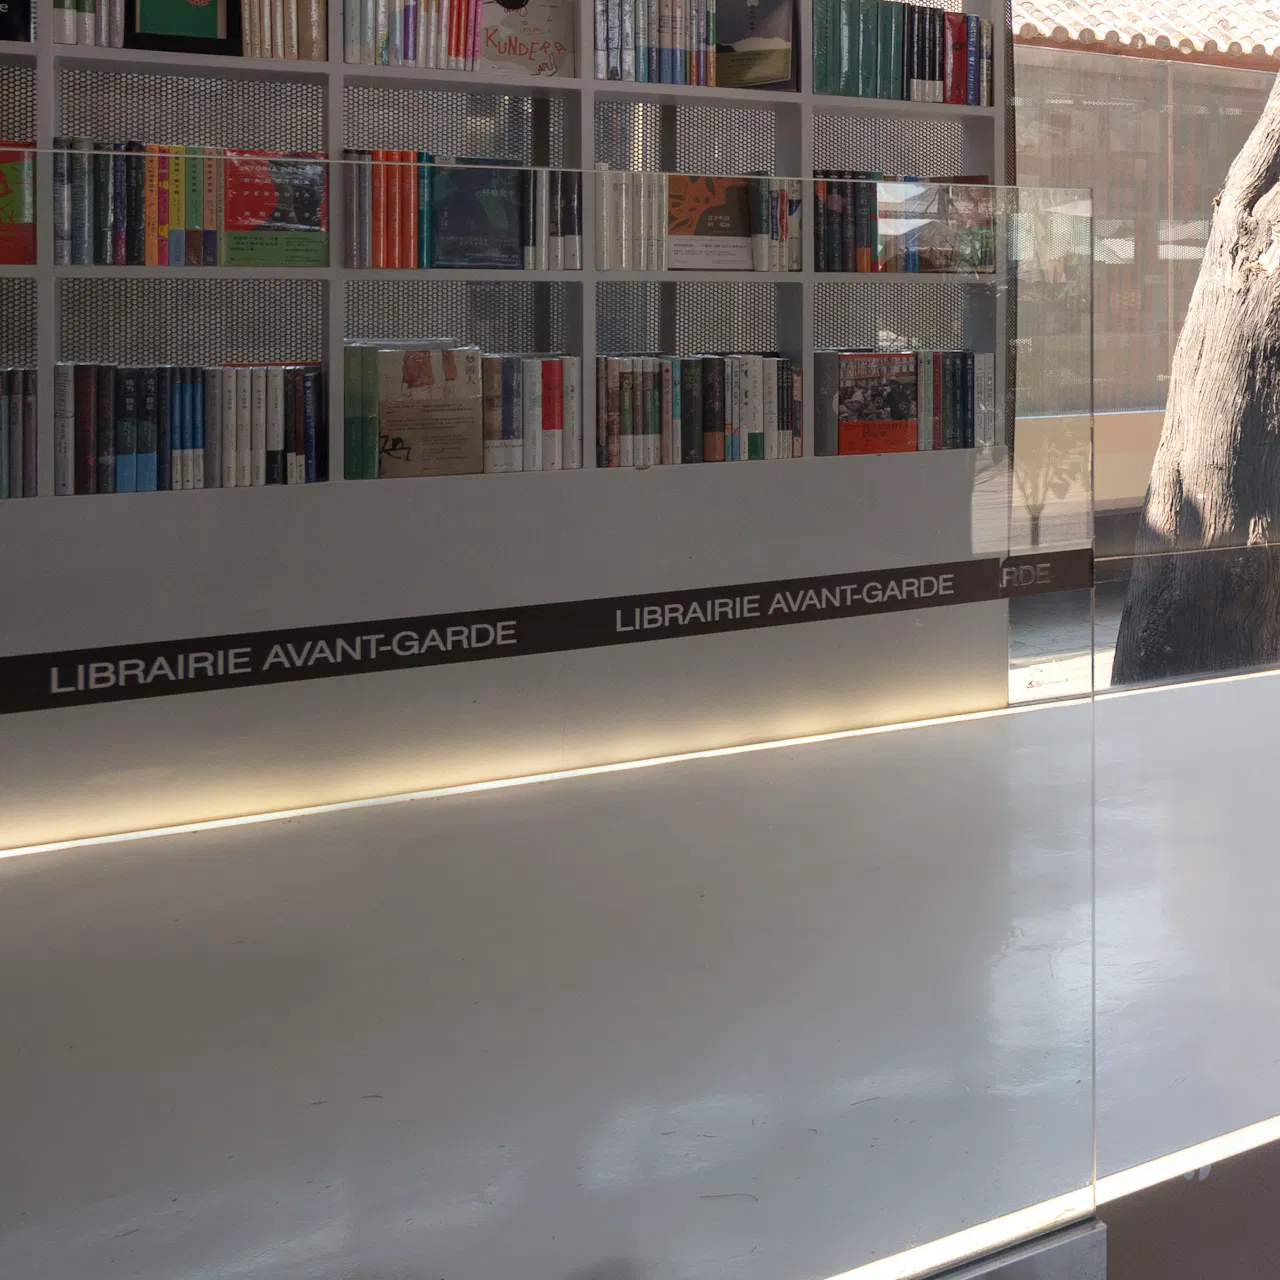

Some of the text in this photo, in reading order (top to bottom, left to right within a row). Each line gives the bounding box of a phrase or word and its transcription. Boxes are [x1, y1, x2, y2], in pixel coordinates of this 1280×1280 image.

[484, 28, 568, 61] KUNDERA
[465, 355, 476, 384] 梦游人
[615, 574, 955, 632] LIBRAIRIE AVANT-GARDE
[50, 620, 518, 694] LIBRAIRIE AVANT-GARDE
